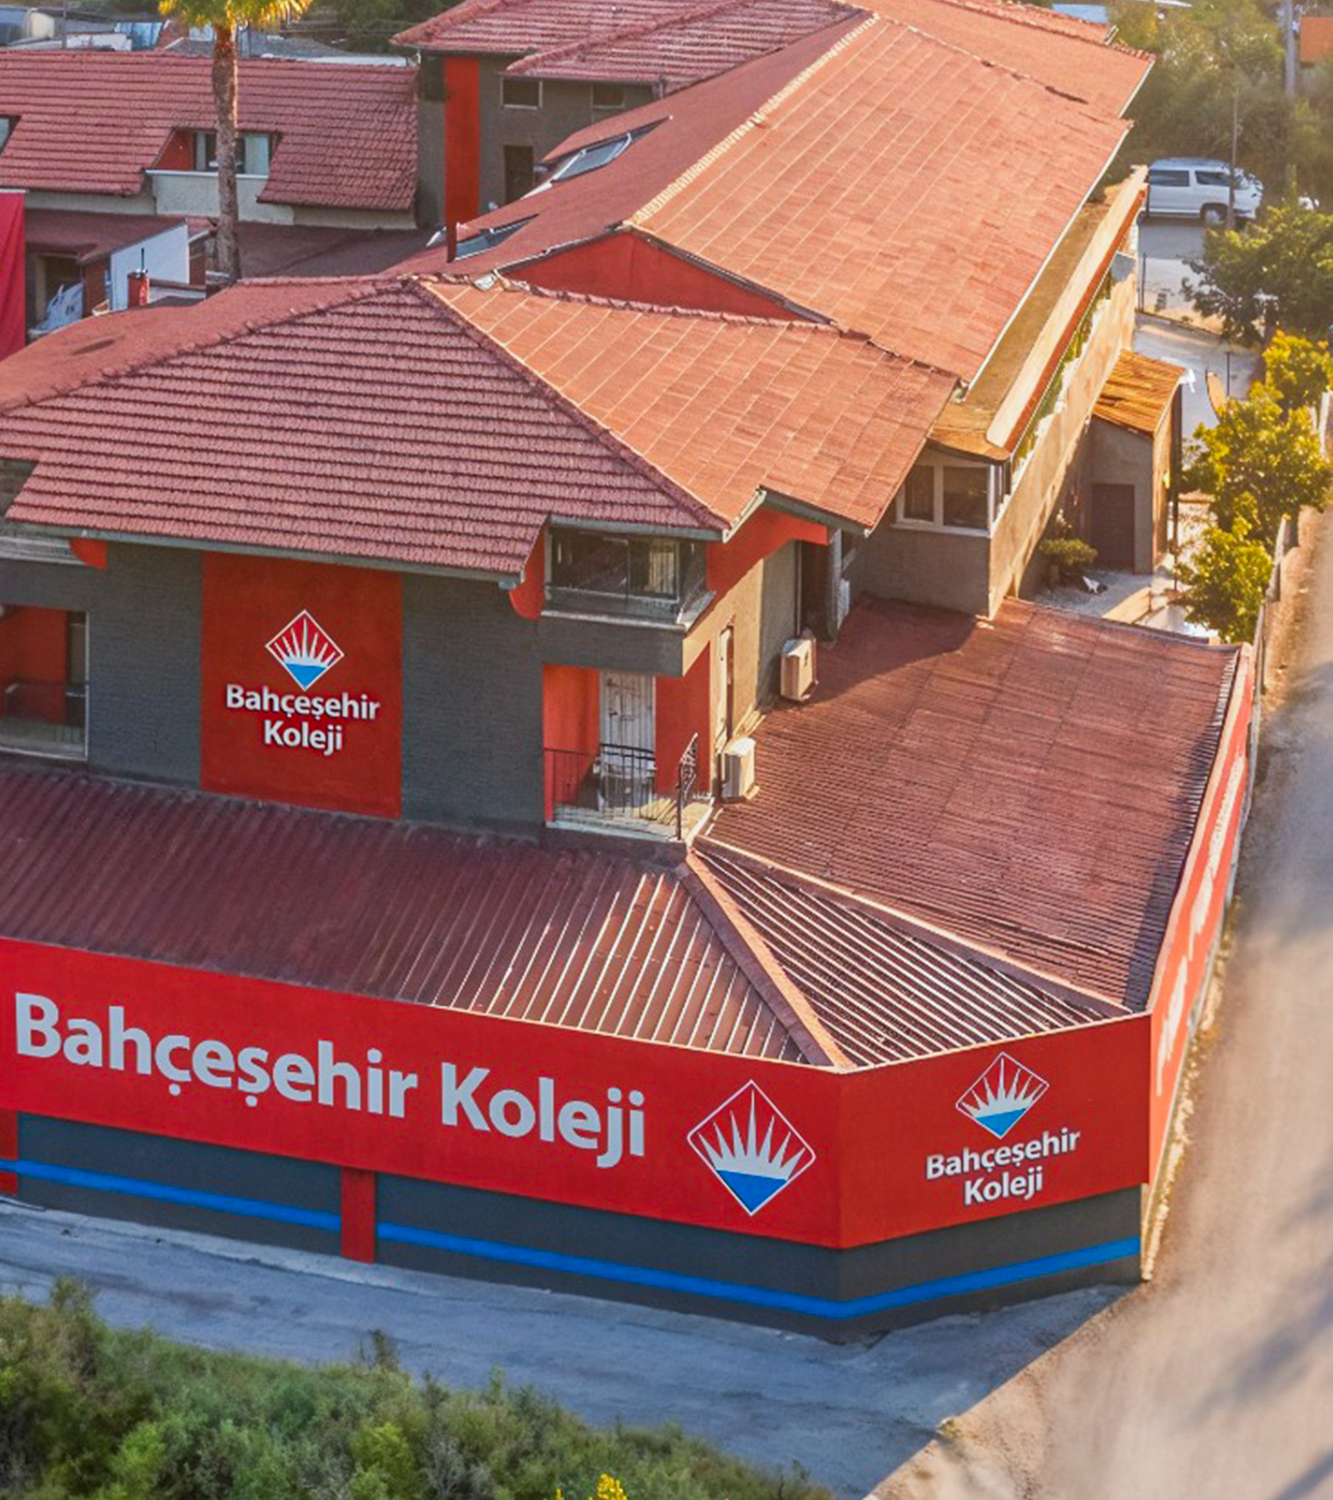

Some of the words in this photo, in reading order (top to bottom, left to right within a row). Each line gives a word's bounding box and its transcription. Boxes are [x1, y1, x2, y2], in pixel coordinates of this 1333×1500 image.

[226, 684, 380, 720] Bahçeşehir
[264, 719, 342, 756] Koleji
[14, 991, 419, 1120] Bahçeşehir
[441, 1062, 646, 1169] Koleji
[926, 1128, 1080, 1180] Bahçeşehir
[964, 1166, 1043, 1205] Koleji
